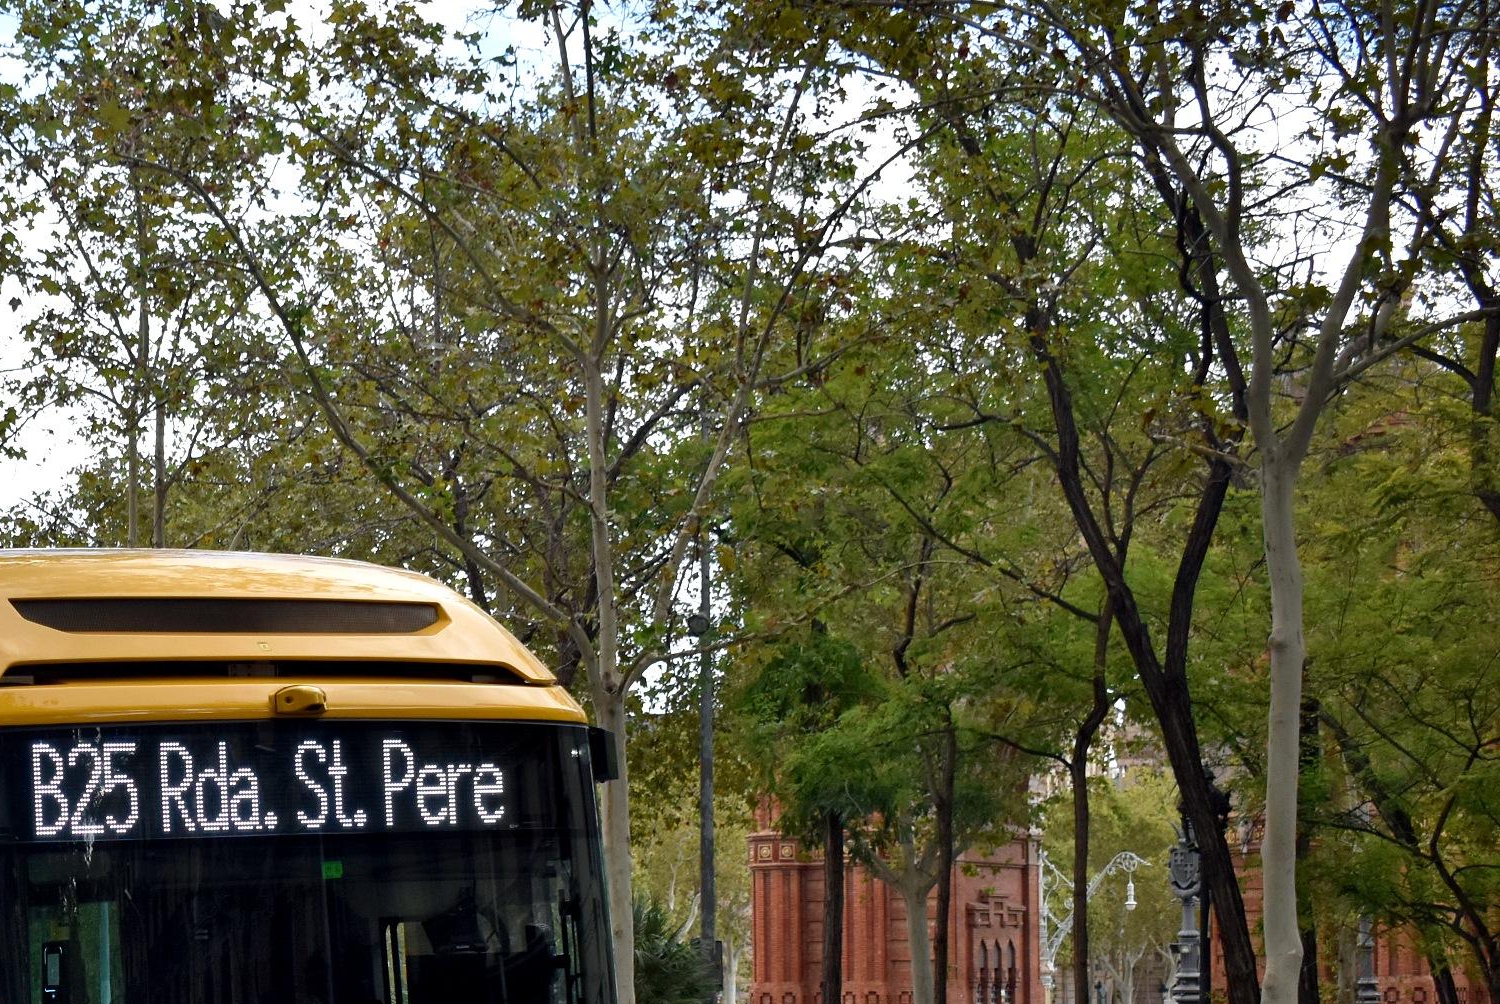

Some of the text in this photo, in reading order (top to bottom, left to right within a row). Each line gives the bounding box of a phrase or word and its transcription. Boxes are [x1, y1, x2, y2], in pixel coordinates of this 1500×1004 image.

[31, 738, 505, 836] B25 Rda. St. Pere
